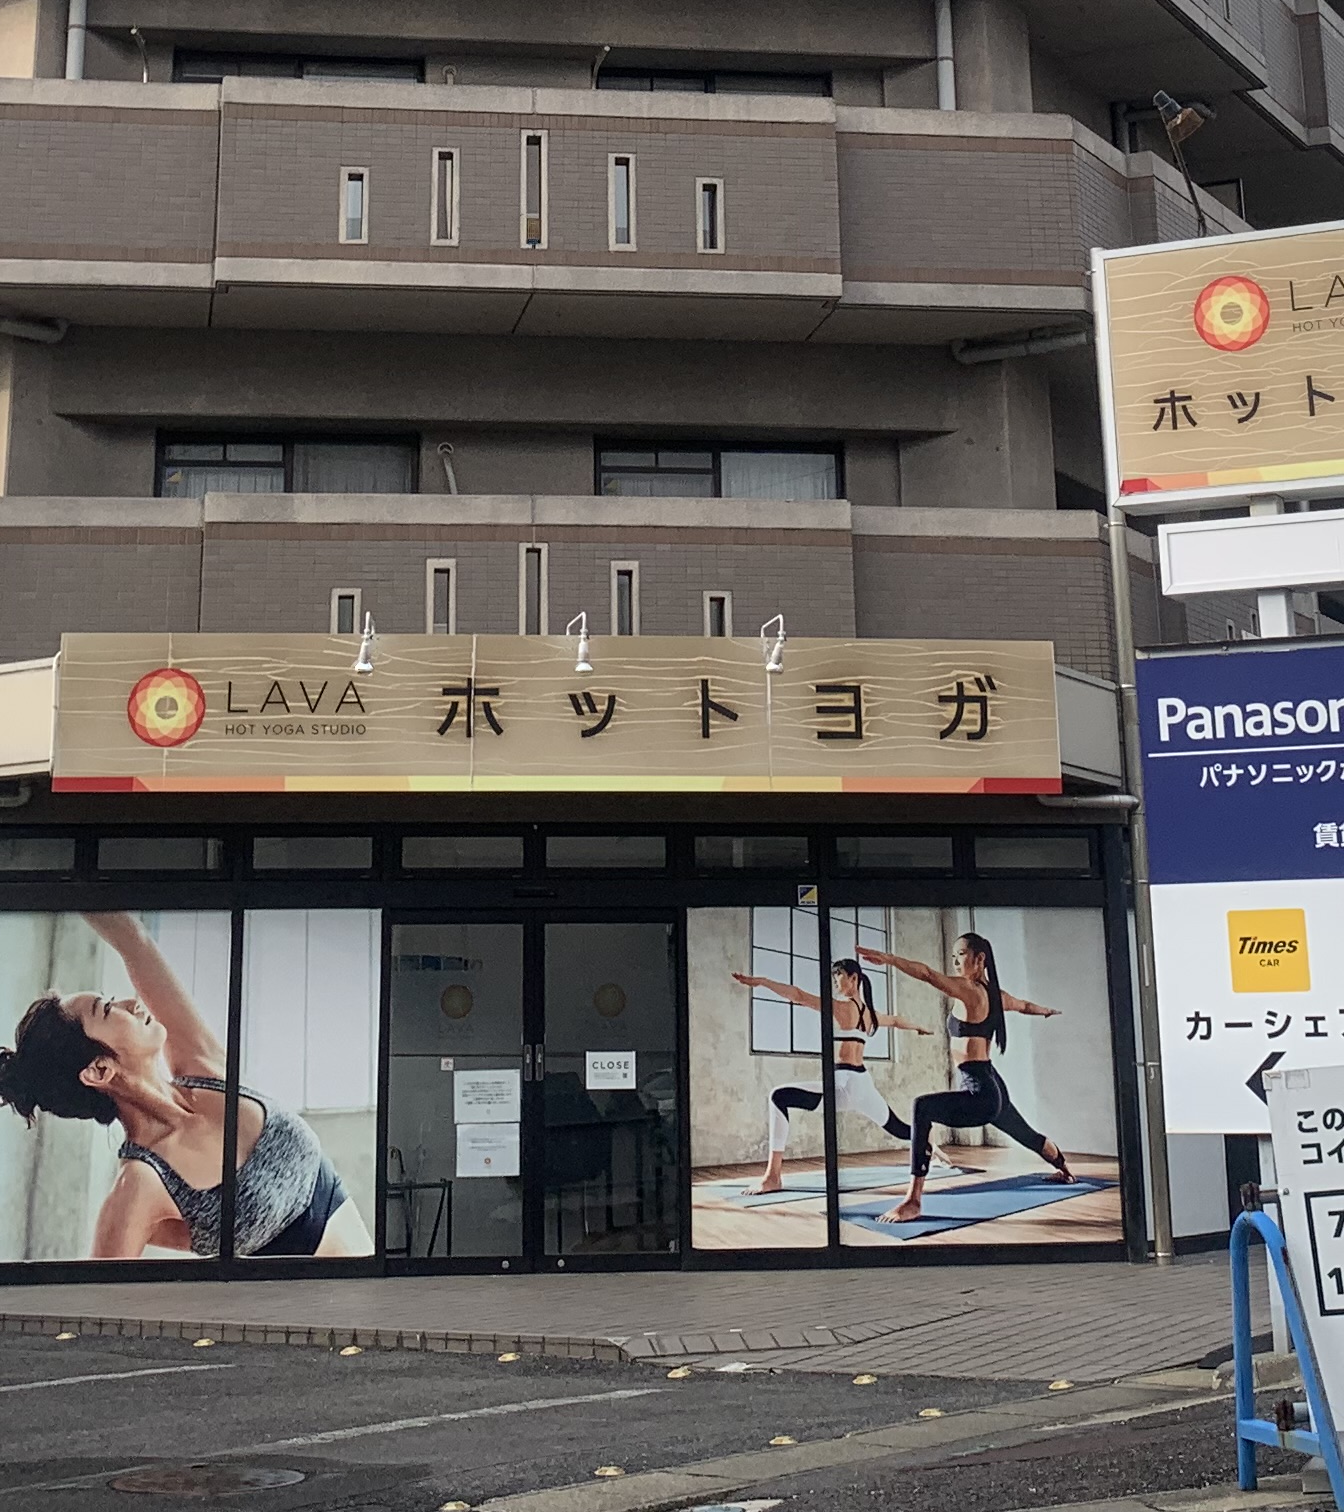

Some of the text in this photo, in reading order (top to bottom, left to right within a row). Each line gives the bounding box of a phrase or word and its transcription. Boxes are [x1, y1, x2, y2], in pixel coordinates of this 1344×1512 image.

[1291, 320, 1323, 333] HOT
[226, 679, 366, 715] LAVA
[437, 674, 998, 740] ホットヨガ
[224, 723, 368, 736] HOT YOGA STUDIO
[1236, 935, 1301, 956] Times
[1258, 957, 1282, 969] CAR
[591, 1060, 630, 1070] CLOSE
